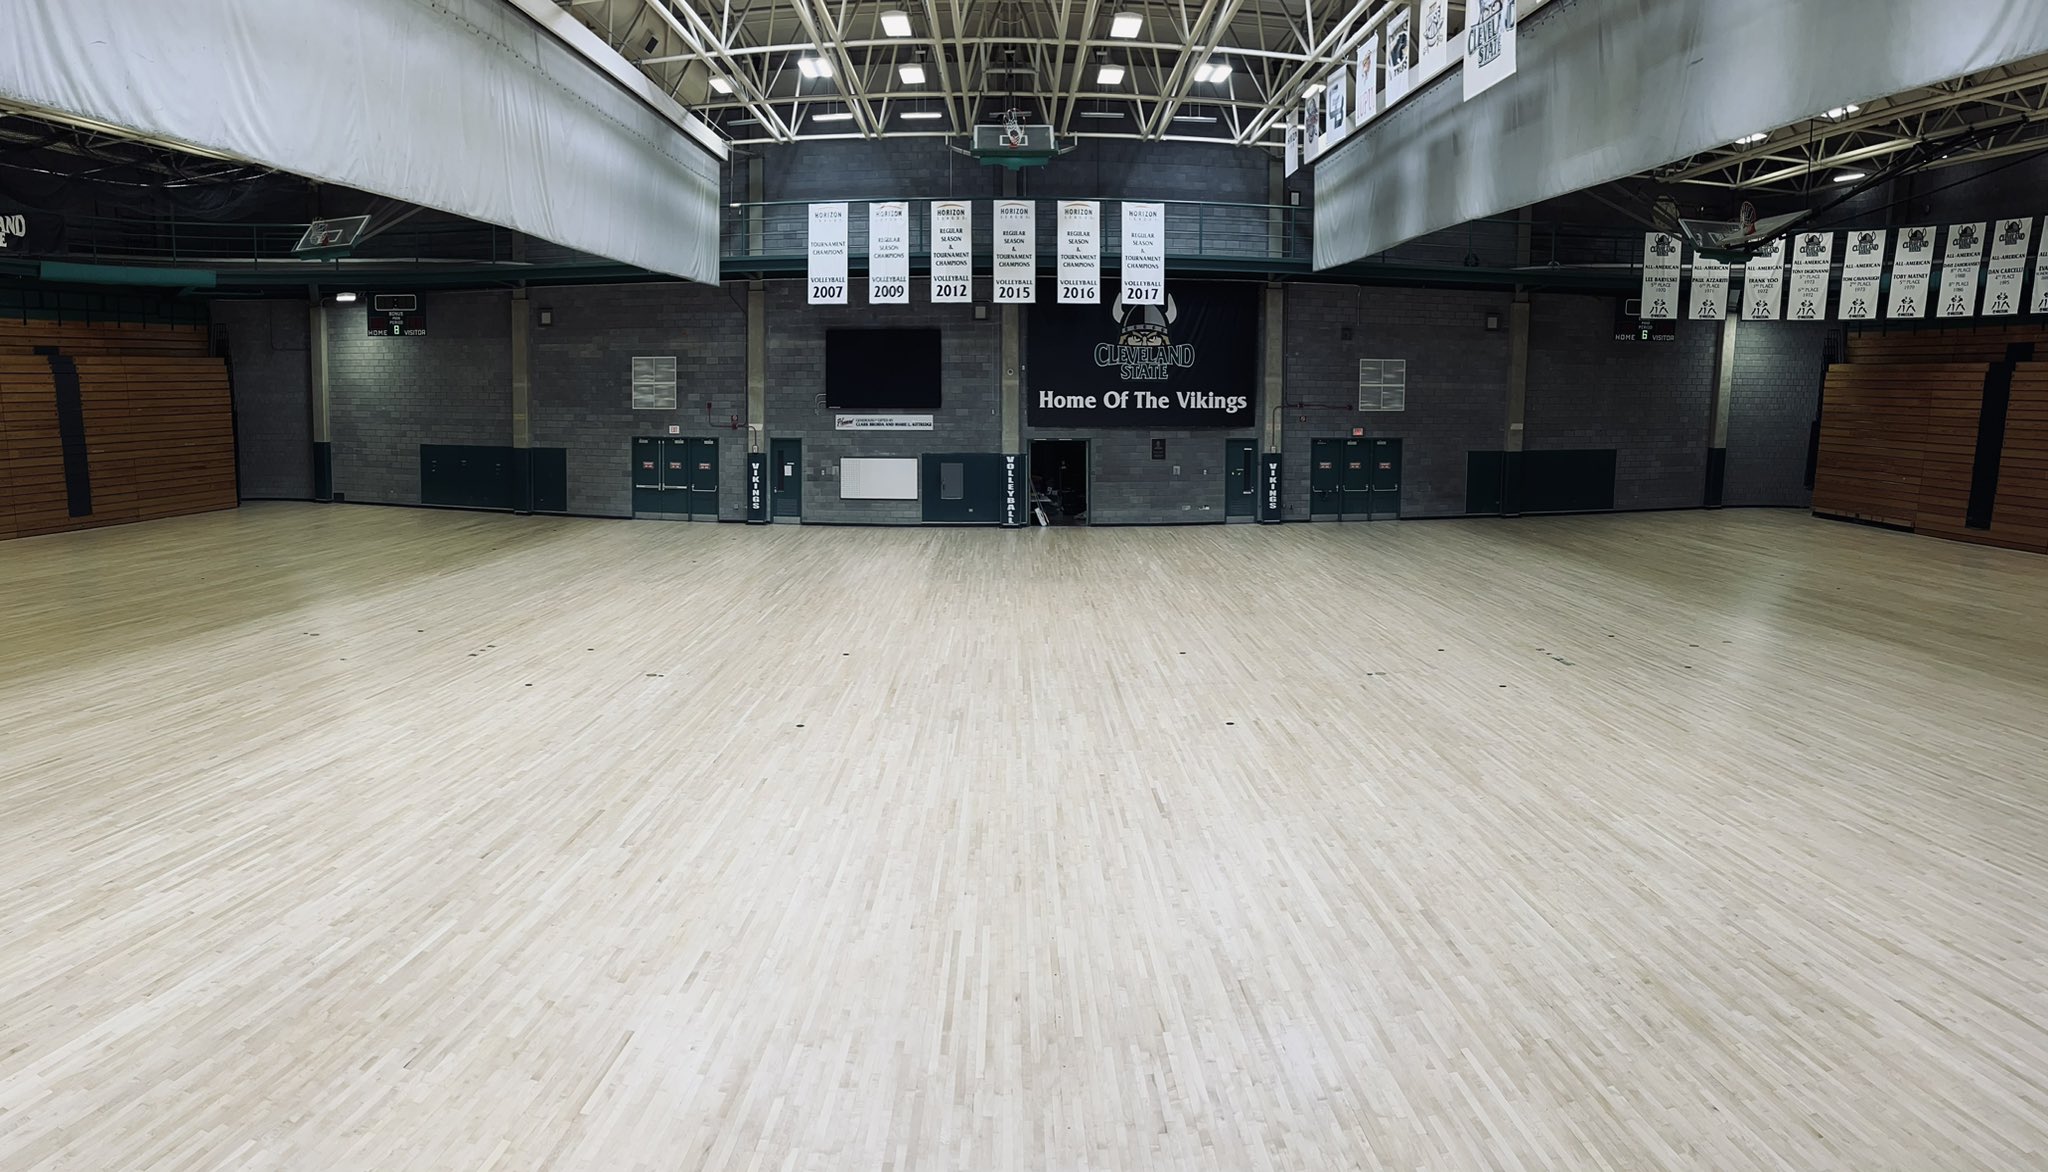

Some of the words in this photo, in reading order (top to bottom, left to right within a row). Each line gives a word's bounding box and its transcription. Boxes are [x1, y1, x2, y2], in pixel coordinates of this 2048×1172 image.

[937, 209, 965, 217] HORIZON
[813, 286, 843, 298] 2007
[874, 286, 904, 298] 2009
[936, 285, 967, 297] 2012
[999, 287, 1031, 299] 2015
[1063, 287, 1095, 299] 2016
[1127, 288, 1158, 300] 2017
[394, 325, 400, 335] 8
[1642, 329, 1648, 340] 6
[1094, 342, 1195, 368] CLEVELAND
[1120, 364, 1169, 380] STATE
[1039, 390, 1097, 409] Home
[1103, 390, 1130, 409] Of
[1133, 391, 1169, 409] The
[1176, 391, 1248, 414] Vikings
[752, 462, 760, 510] VIKINGS
[1006, 456, 1016, 524] VOLLEYBALL
[1269, 463, 1278, 510] VIKINGS
